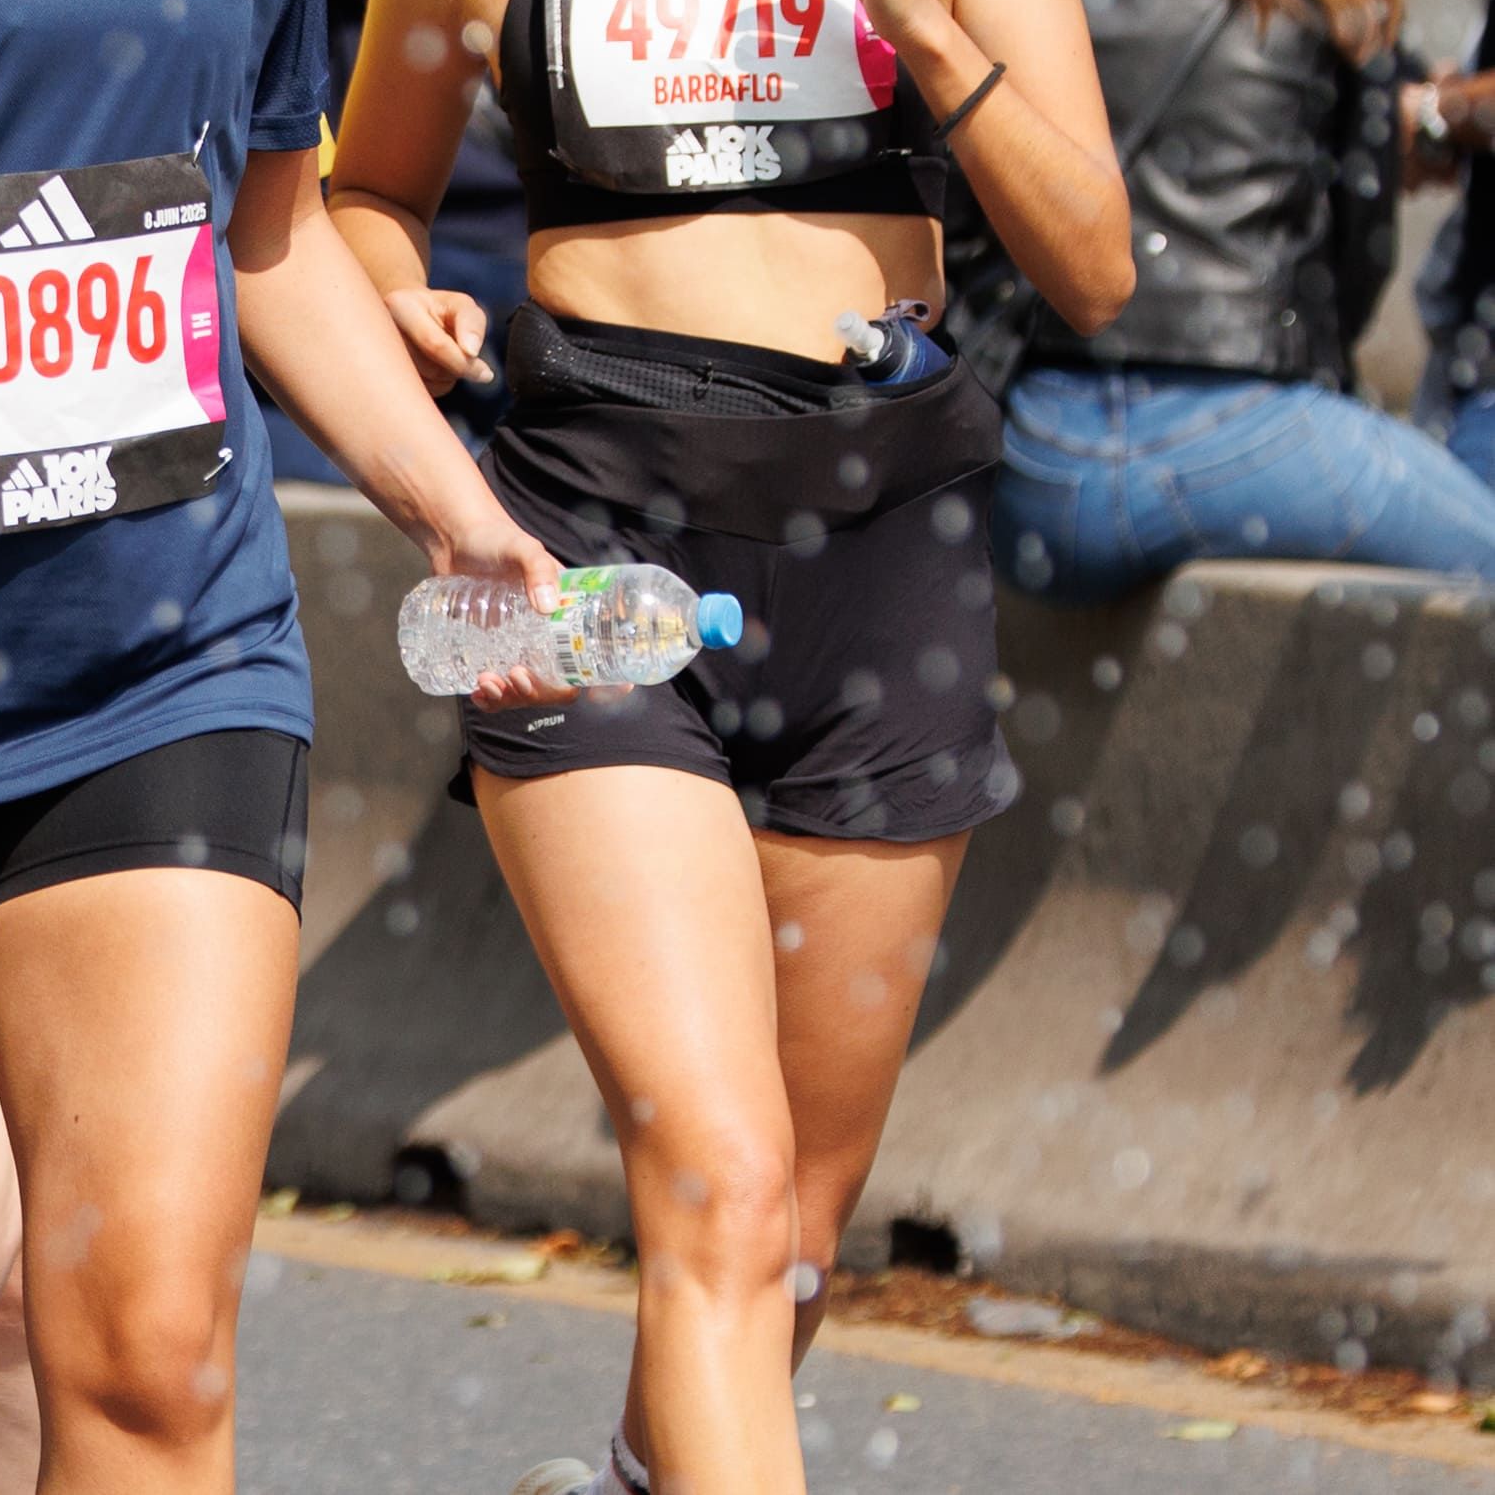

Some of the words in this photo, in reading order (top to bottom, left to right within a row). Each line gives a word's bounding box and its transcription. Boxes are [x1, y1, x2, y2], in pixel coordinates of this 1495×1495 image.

[654, 72, 783, 106] BARBAFLO
[704, 125, 776, 155] 10K
[666, 151, 782, 187] PARIS
[144, 211, 153, 230] 8
[153, 207, 180, 228] JUIN
[180, 202, 207, 224] 2025
[42, 446, 114, 488] 10K
[1, 479, 117, 527] PARIS
